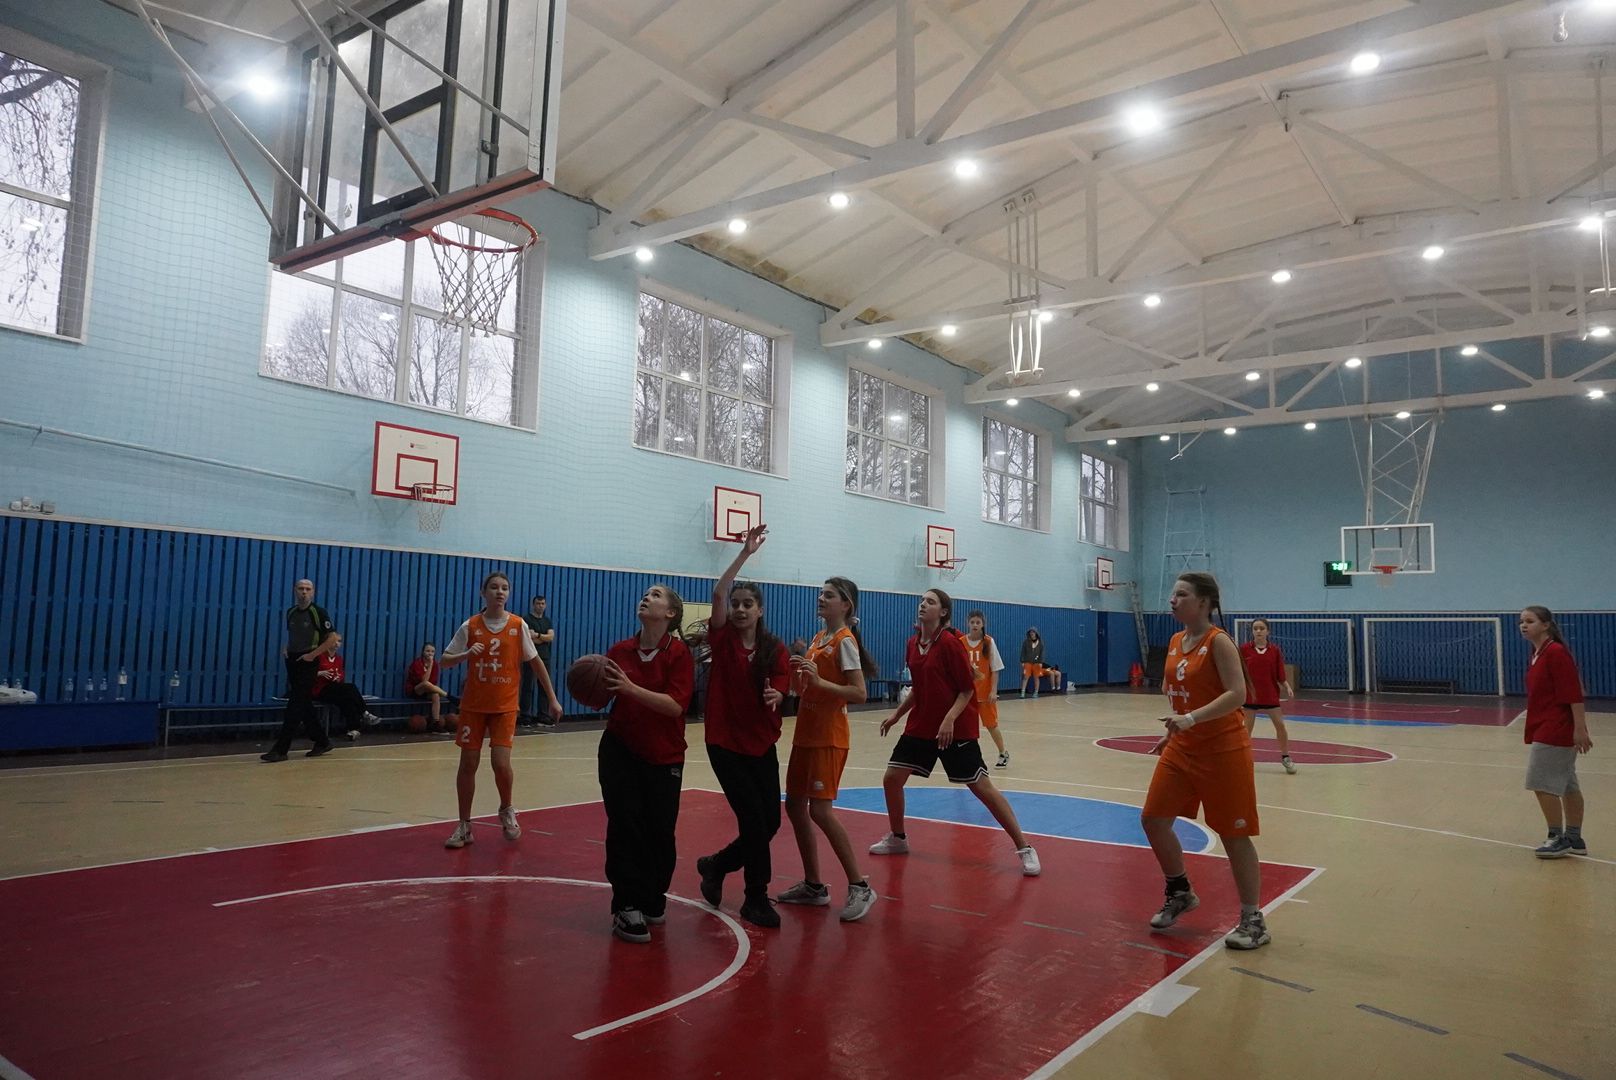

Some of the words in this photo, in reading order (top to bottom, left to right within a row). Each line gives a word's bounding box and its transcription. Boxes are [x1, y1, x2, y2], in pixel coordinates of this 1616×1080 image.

[489, 638, 501, 655] 2
[969, 650, 980, 661] 11
[461, 725, 471, 743] 2
